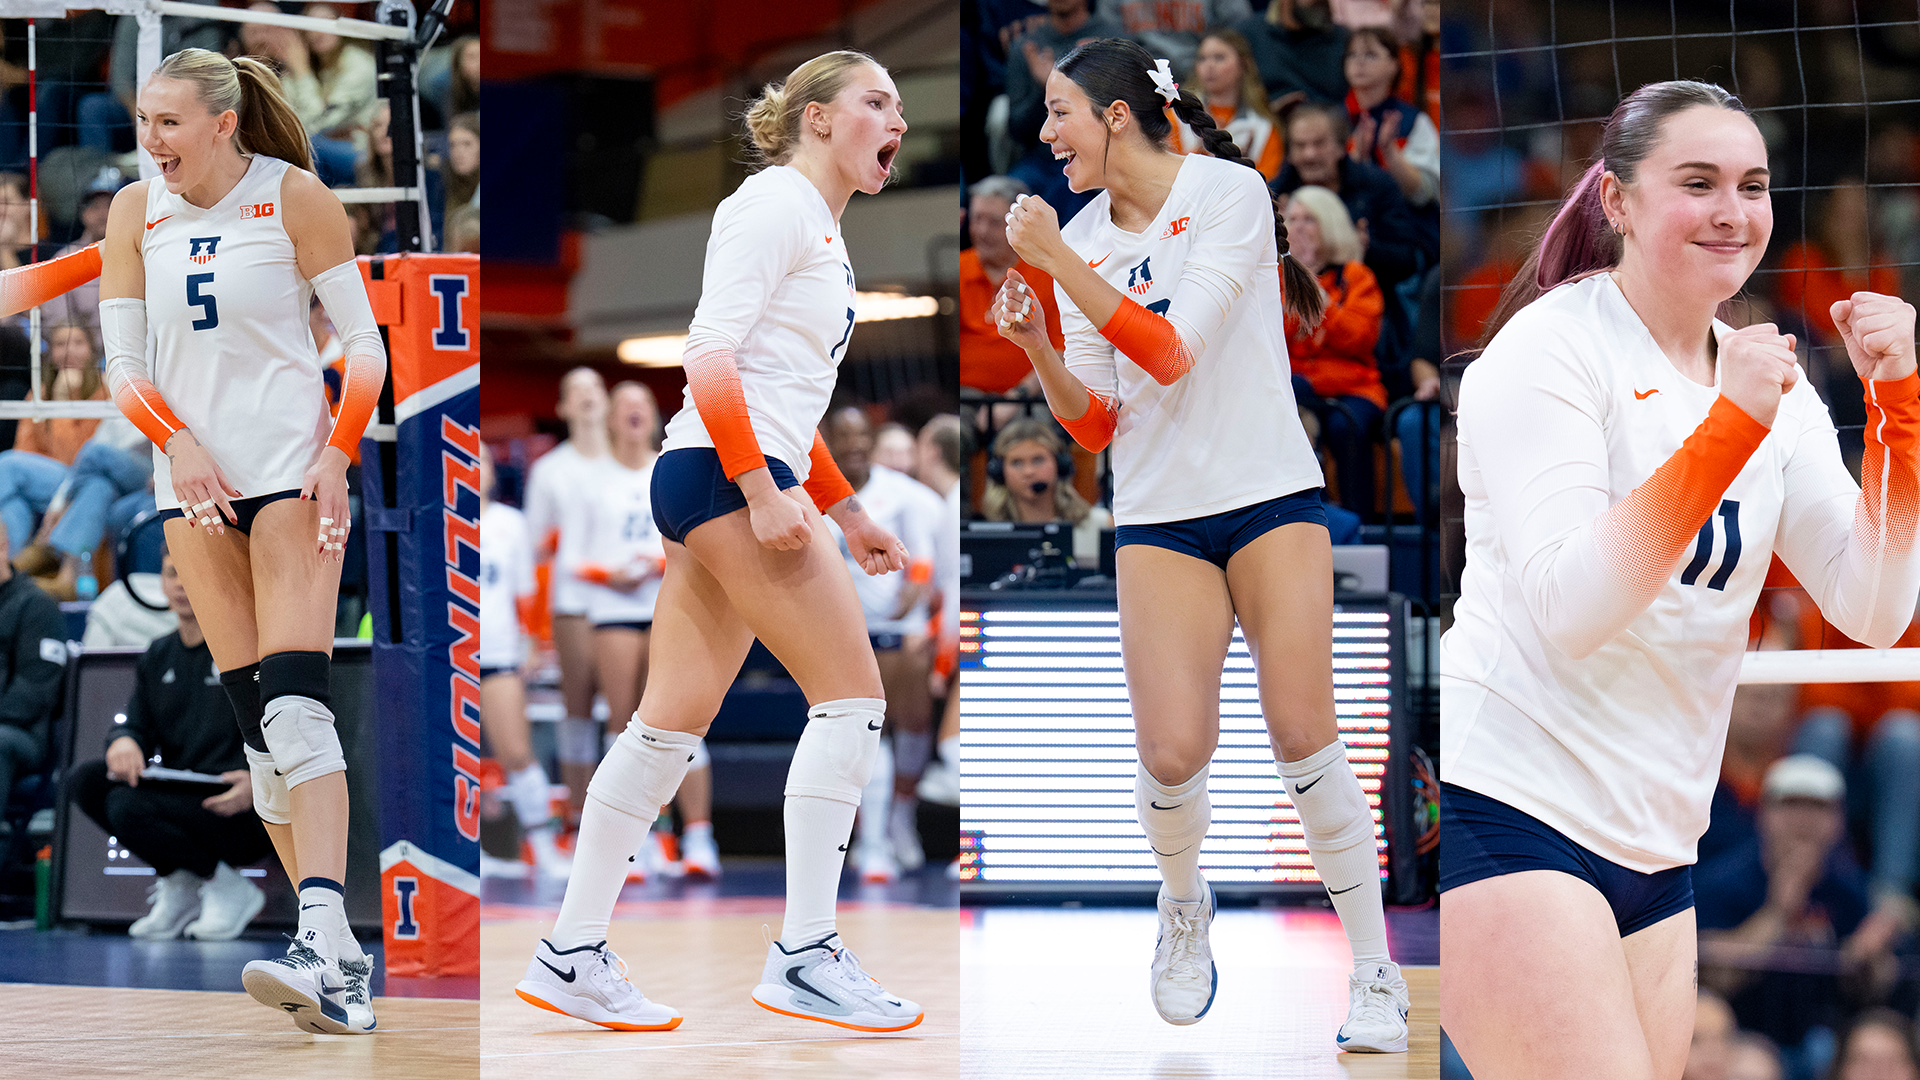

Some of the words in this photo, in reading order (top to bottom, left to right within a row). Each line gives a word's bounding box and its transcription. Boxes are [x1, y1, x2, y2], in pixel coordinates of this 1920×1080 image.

[186, 271, 219, 332] 5
[429, 274, 470, 351] I
[830, 306, 856, 360] 7
[1680, 498, 1743, 592] 11
[393, 876, 420, 940] I
